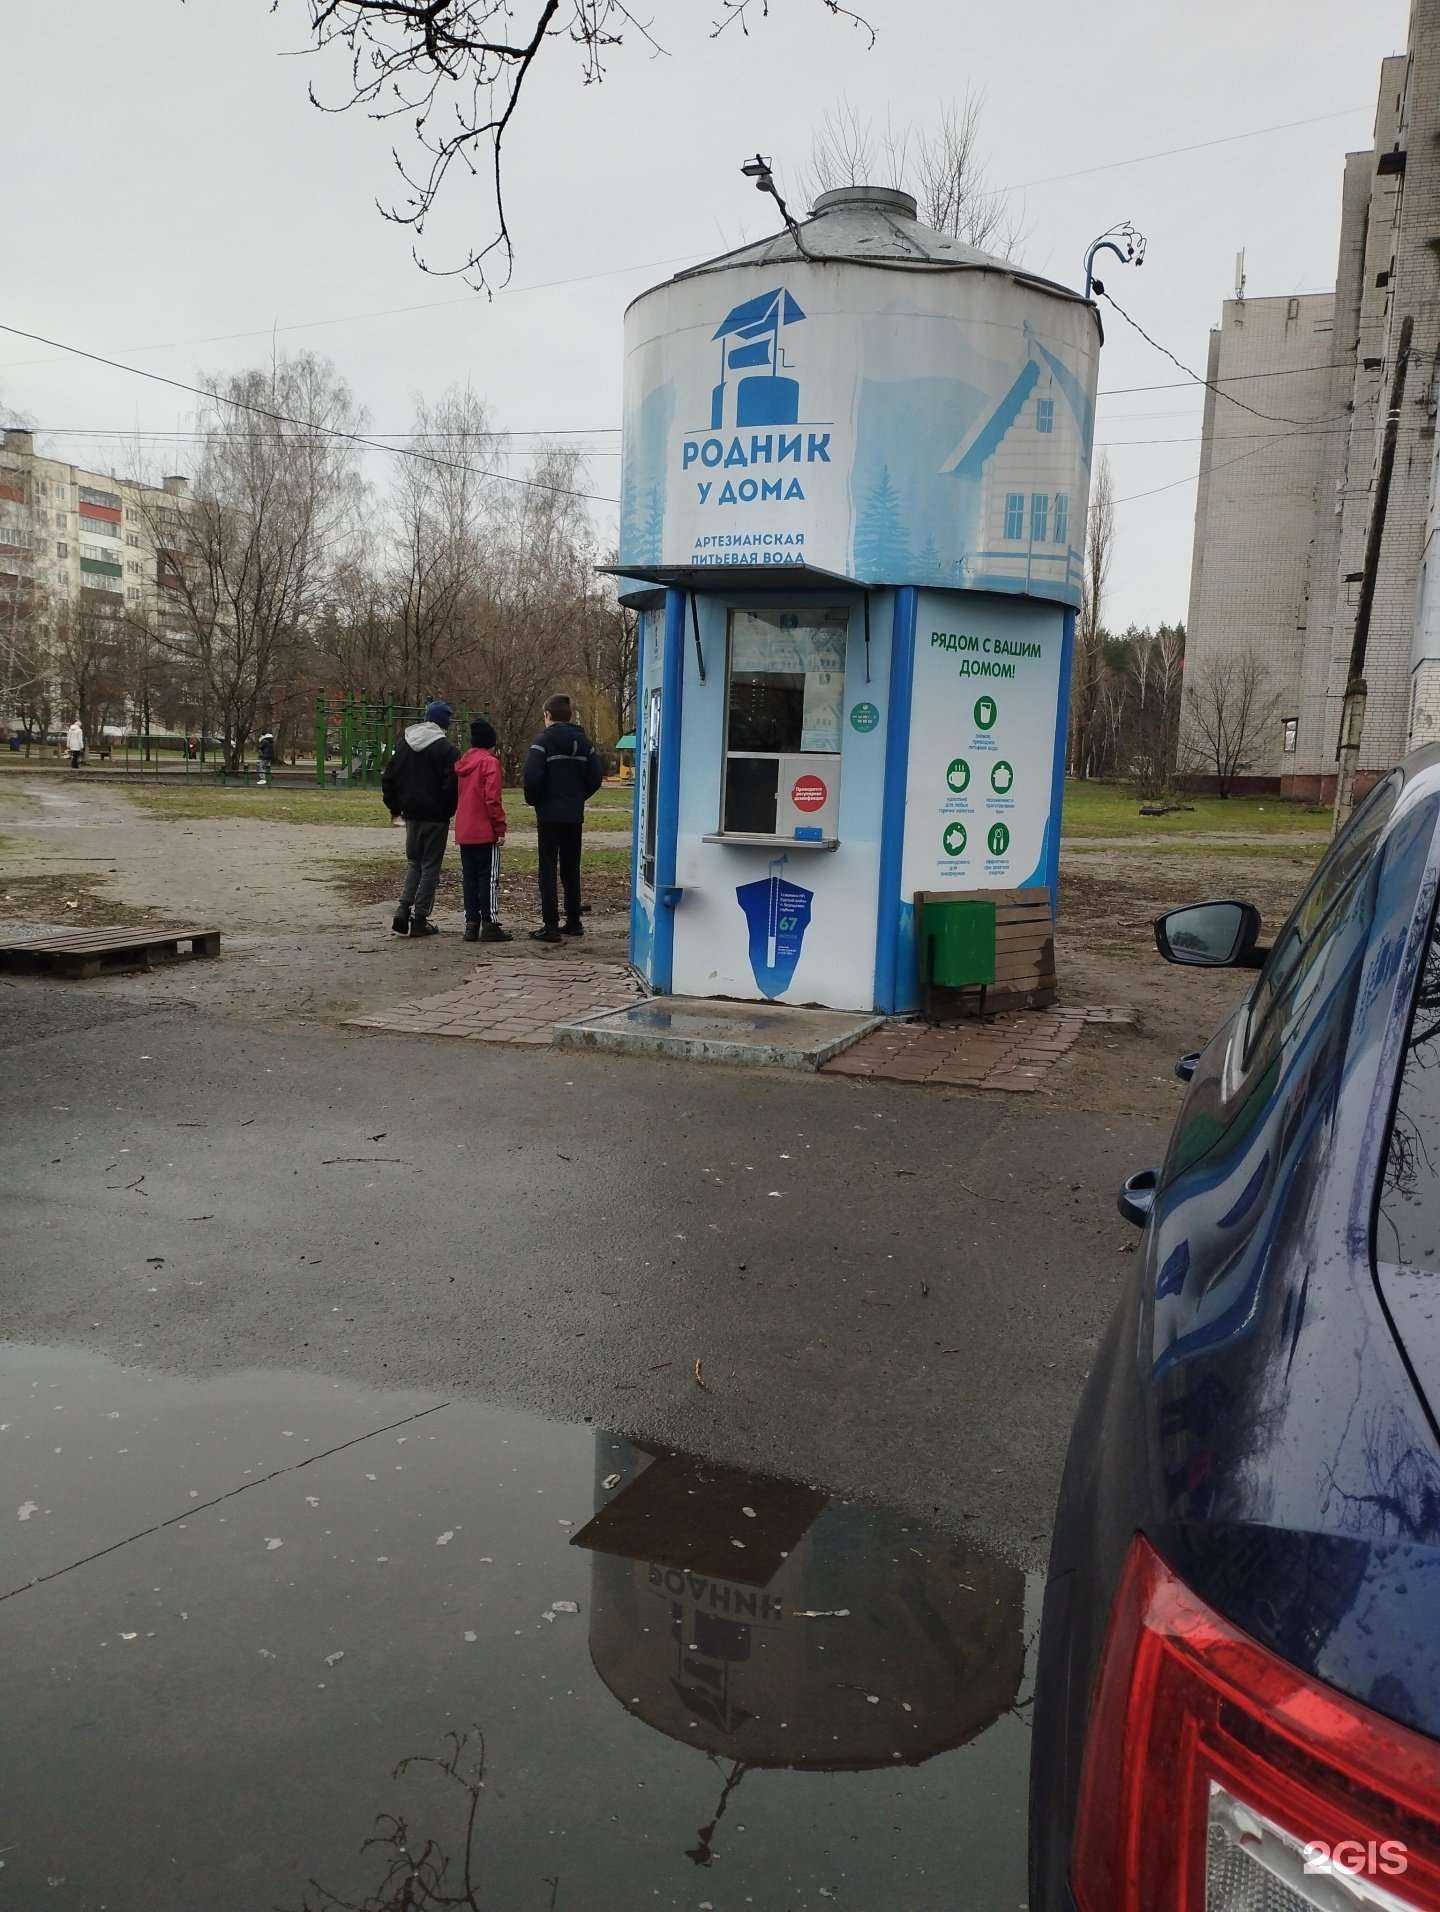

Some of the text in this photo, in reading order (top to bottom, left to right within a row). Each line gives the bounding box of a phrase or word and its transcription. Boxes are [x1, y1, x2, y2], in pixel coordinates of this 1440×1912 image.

[682, 433, 831, 470] РОДНИК
[697, 477, 805, 506] У ДОМА
[694, 533, 805, 548] АРТЕЗИАНСКАЯ
[691, 551, 805, 565] ПИТЬЕВАЯ ВОДА
[931, 631, 1041, 658] РЯДОМ С ВАШИМ
[959, 659, 1016, 678] ДОМОМ!
[779, 916, 798, 931] 67
